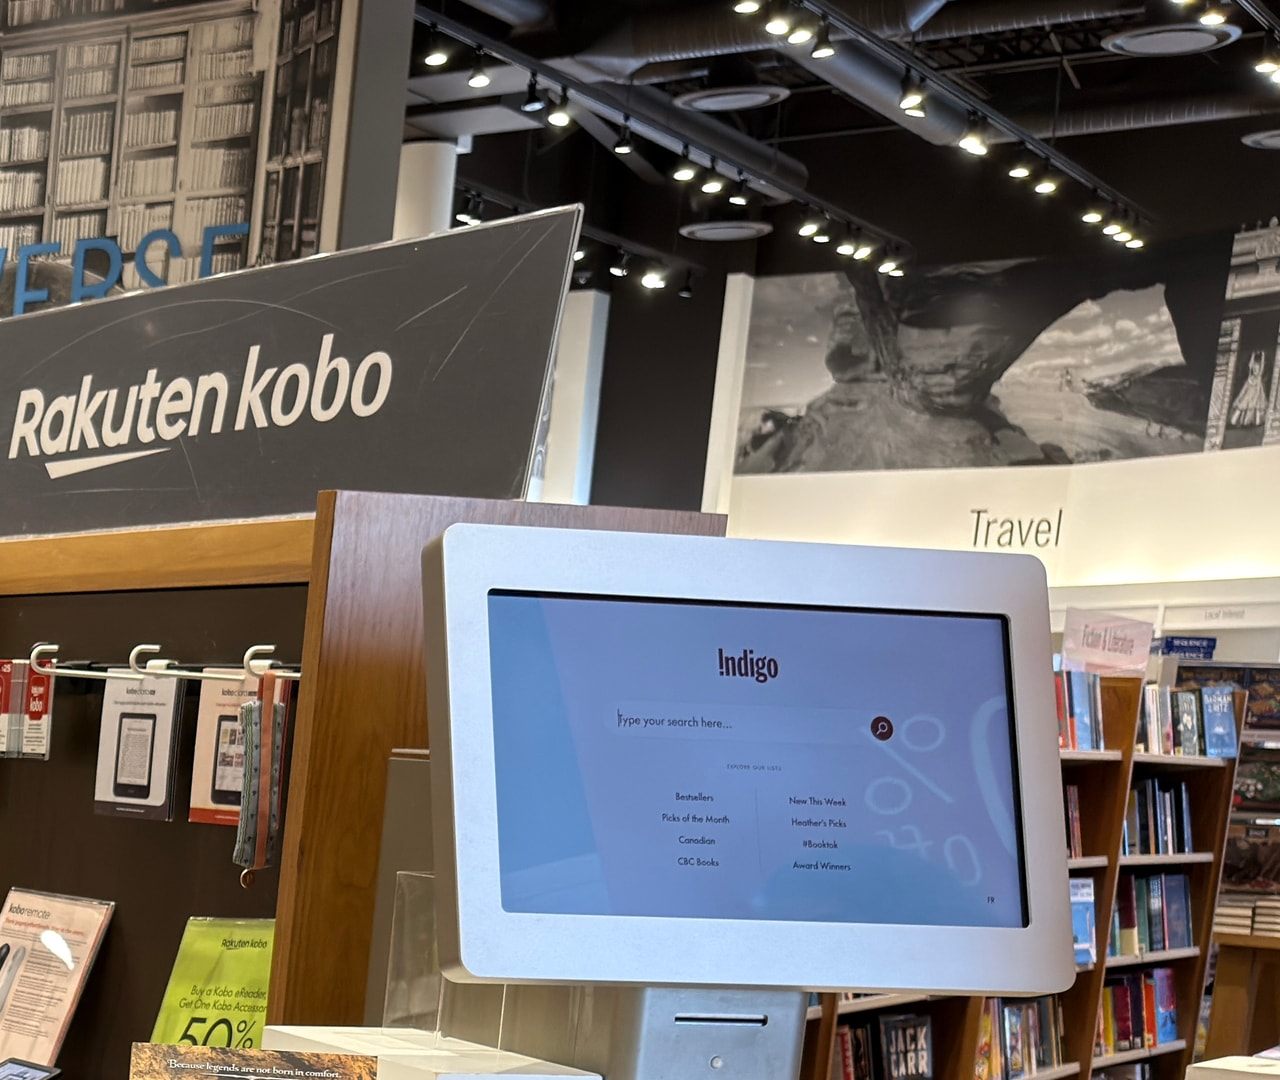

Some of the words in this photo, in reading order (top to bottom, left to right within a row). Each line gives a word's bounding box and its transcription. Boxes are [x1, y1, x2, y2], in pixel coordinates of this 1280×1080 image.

[9, 368, 228, 459] Rakuten
[234, 333, 393, 434] kobo
[970, 508, 1063, 548] Travel
[618, 714, 640, 727] Type
[643, 717, 664, 728] your
[667, 716, 699, 728] search
[700, 717, 732, 729] here...
[675, 792, 714, 802] Bestsellers
[791, 818, 827, 828] Heather's
[829, 819, 847, 828] Picks
[679, 834, 715, 845] Canadian
[678, 855, 695, 866] CBC
[696, 858, 719, 867] Books
[793, 861, 819, 871] Award
[820, 862, 851, 872] Winners
